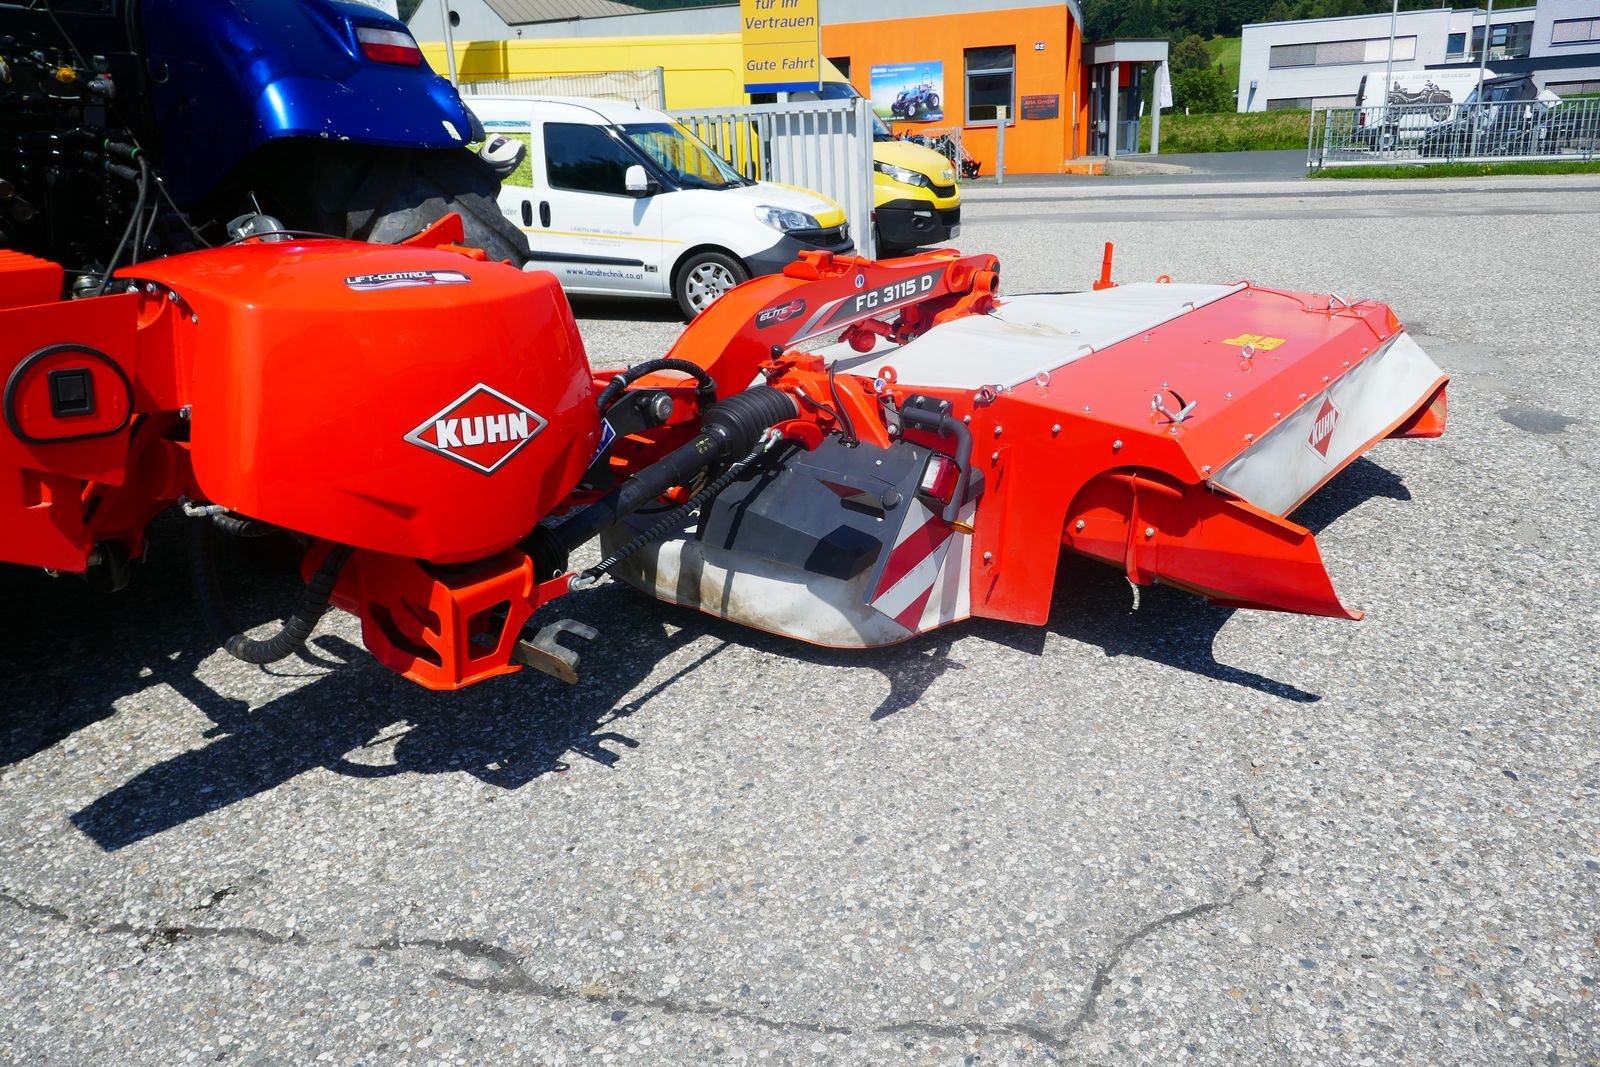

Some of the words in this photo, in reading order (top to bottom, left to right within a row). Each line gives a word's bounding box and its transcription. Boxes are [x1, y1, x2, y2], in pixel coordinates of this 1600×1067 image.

[745, 16, 815, 30] Vertrauen
[746, 59, 777, 71] Gute
[782, 57, 815, 70] Fahrt
[346, 271, 432, 284] LIFT-CONTROL
[565, 268, 643, 280] www.landtechnik.co.at
[855, 291, 879, 312] FC
[883, 278, 917, 303] 3115
[921, 274, 933, 291] D
[435, 411, 529, 449] KUHN
[1311, 407, 1336, 447] KUHN
